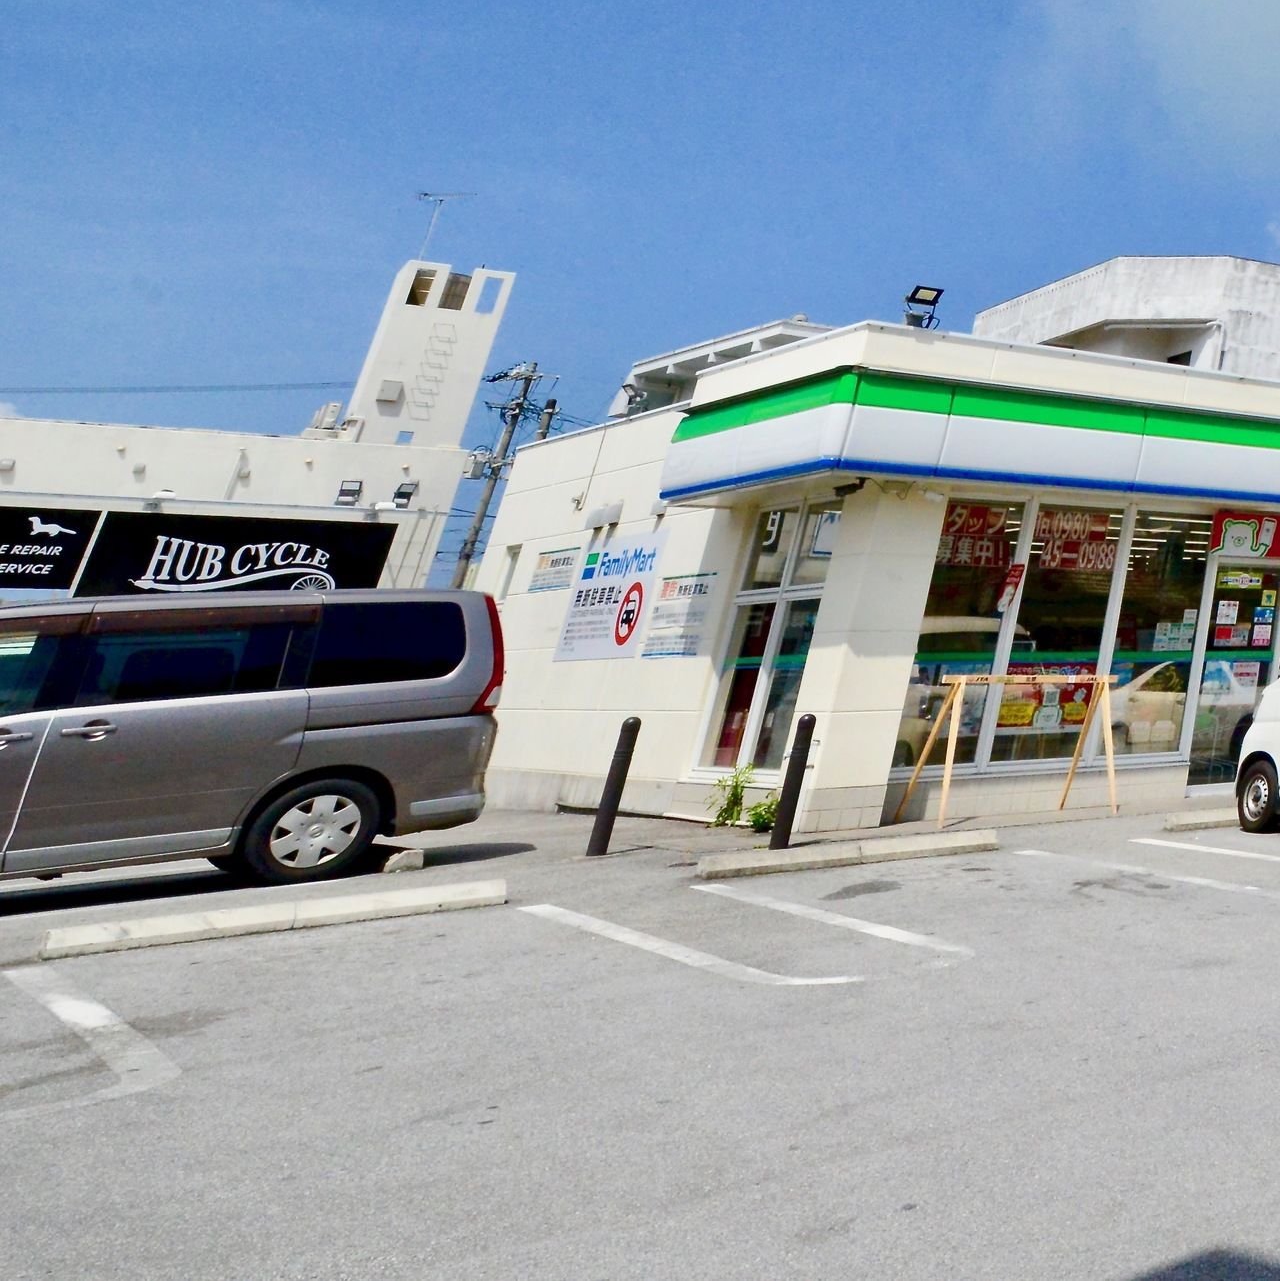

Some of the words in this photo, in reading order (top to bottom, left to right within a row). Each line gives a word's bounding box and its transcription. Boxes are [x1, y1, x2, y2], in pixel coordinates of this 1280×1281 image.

[10, 545, 63, 556] REPAIR
[141, 535, 226, 582] HUB
[231, 541, 331, 577] CYCLE
[597, 548, 656, 579] FamilyMart
[573, 586, 622, 608] 無断駐車禁止
